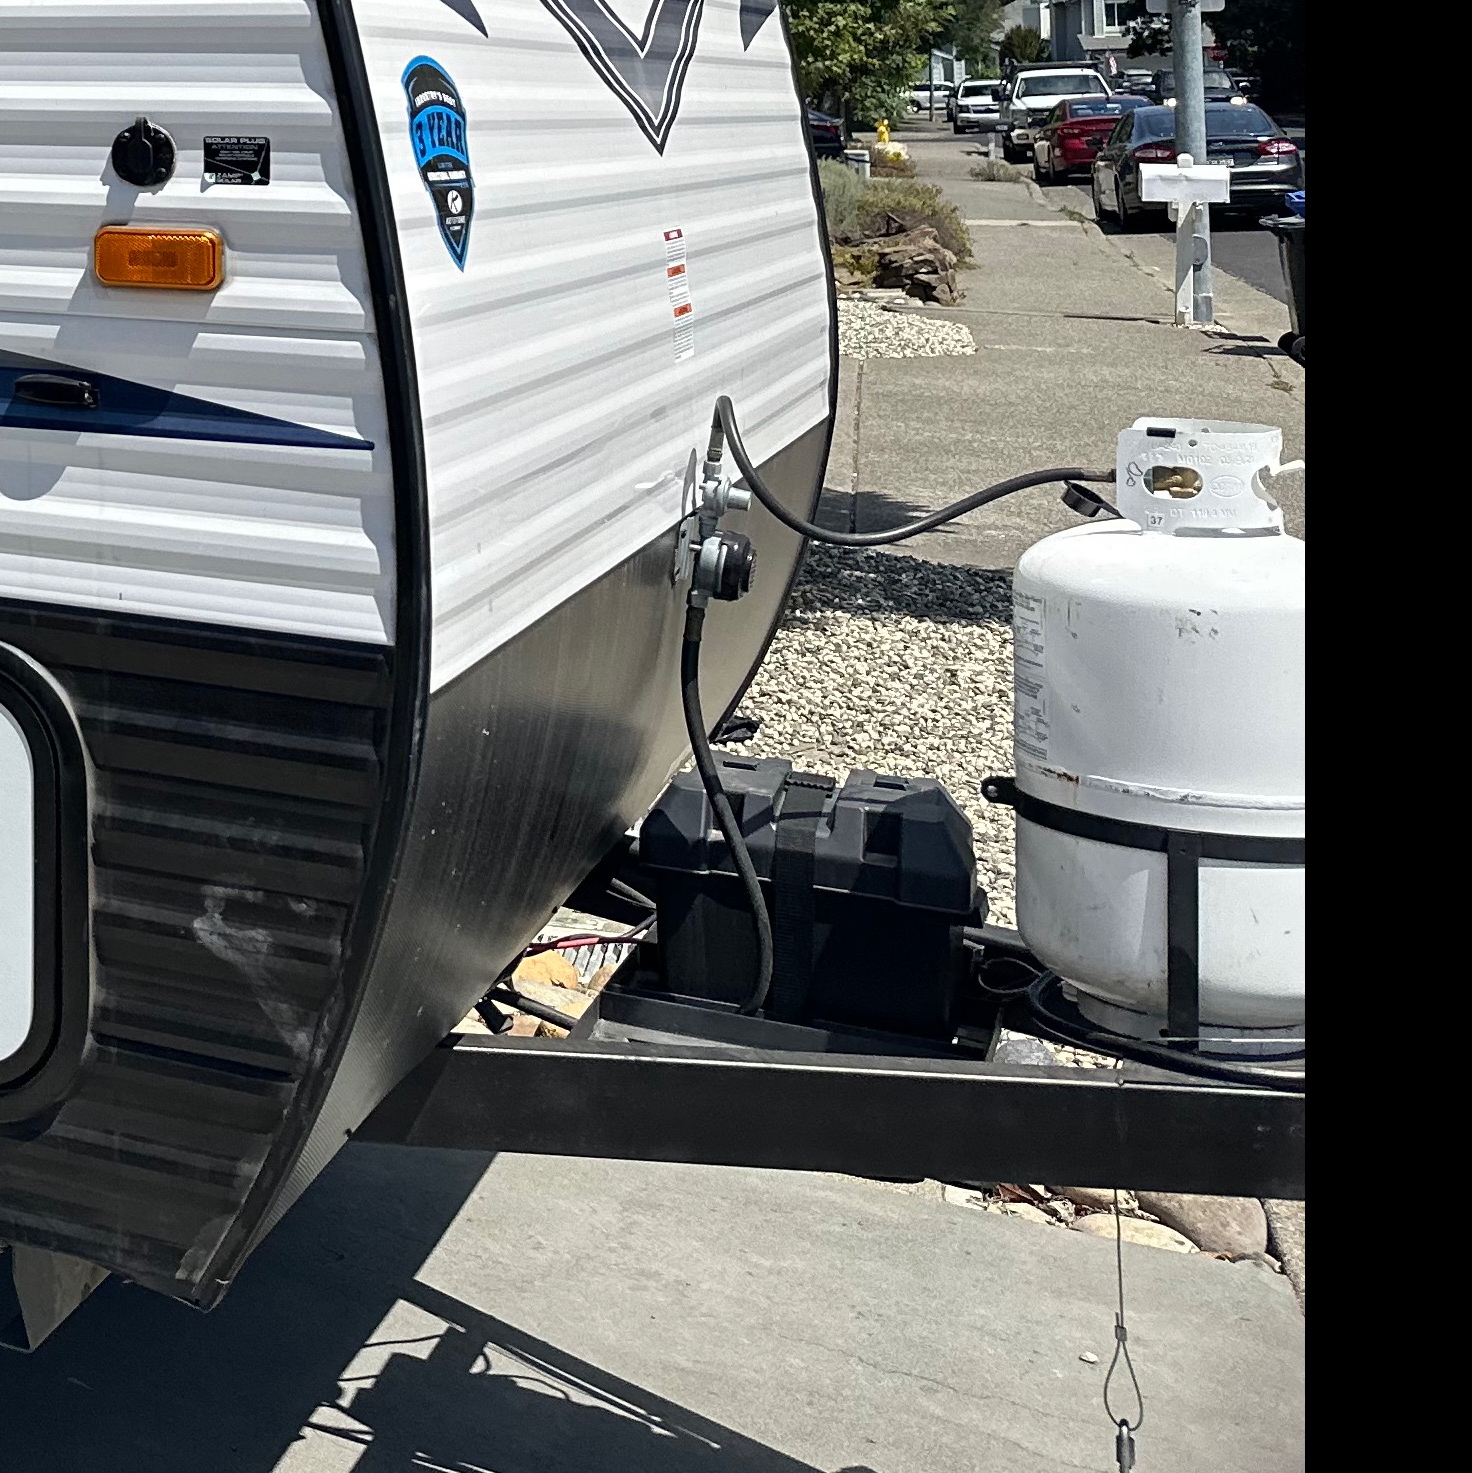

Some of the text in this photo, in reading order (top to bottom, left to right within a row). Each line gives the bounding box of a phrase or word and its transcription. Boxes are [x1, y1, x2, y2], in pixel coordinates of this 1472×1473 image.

[415, 111, 466, 158] 3 YEAR
[1150, 516, 1163, 526] 37
